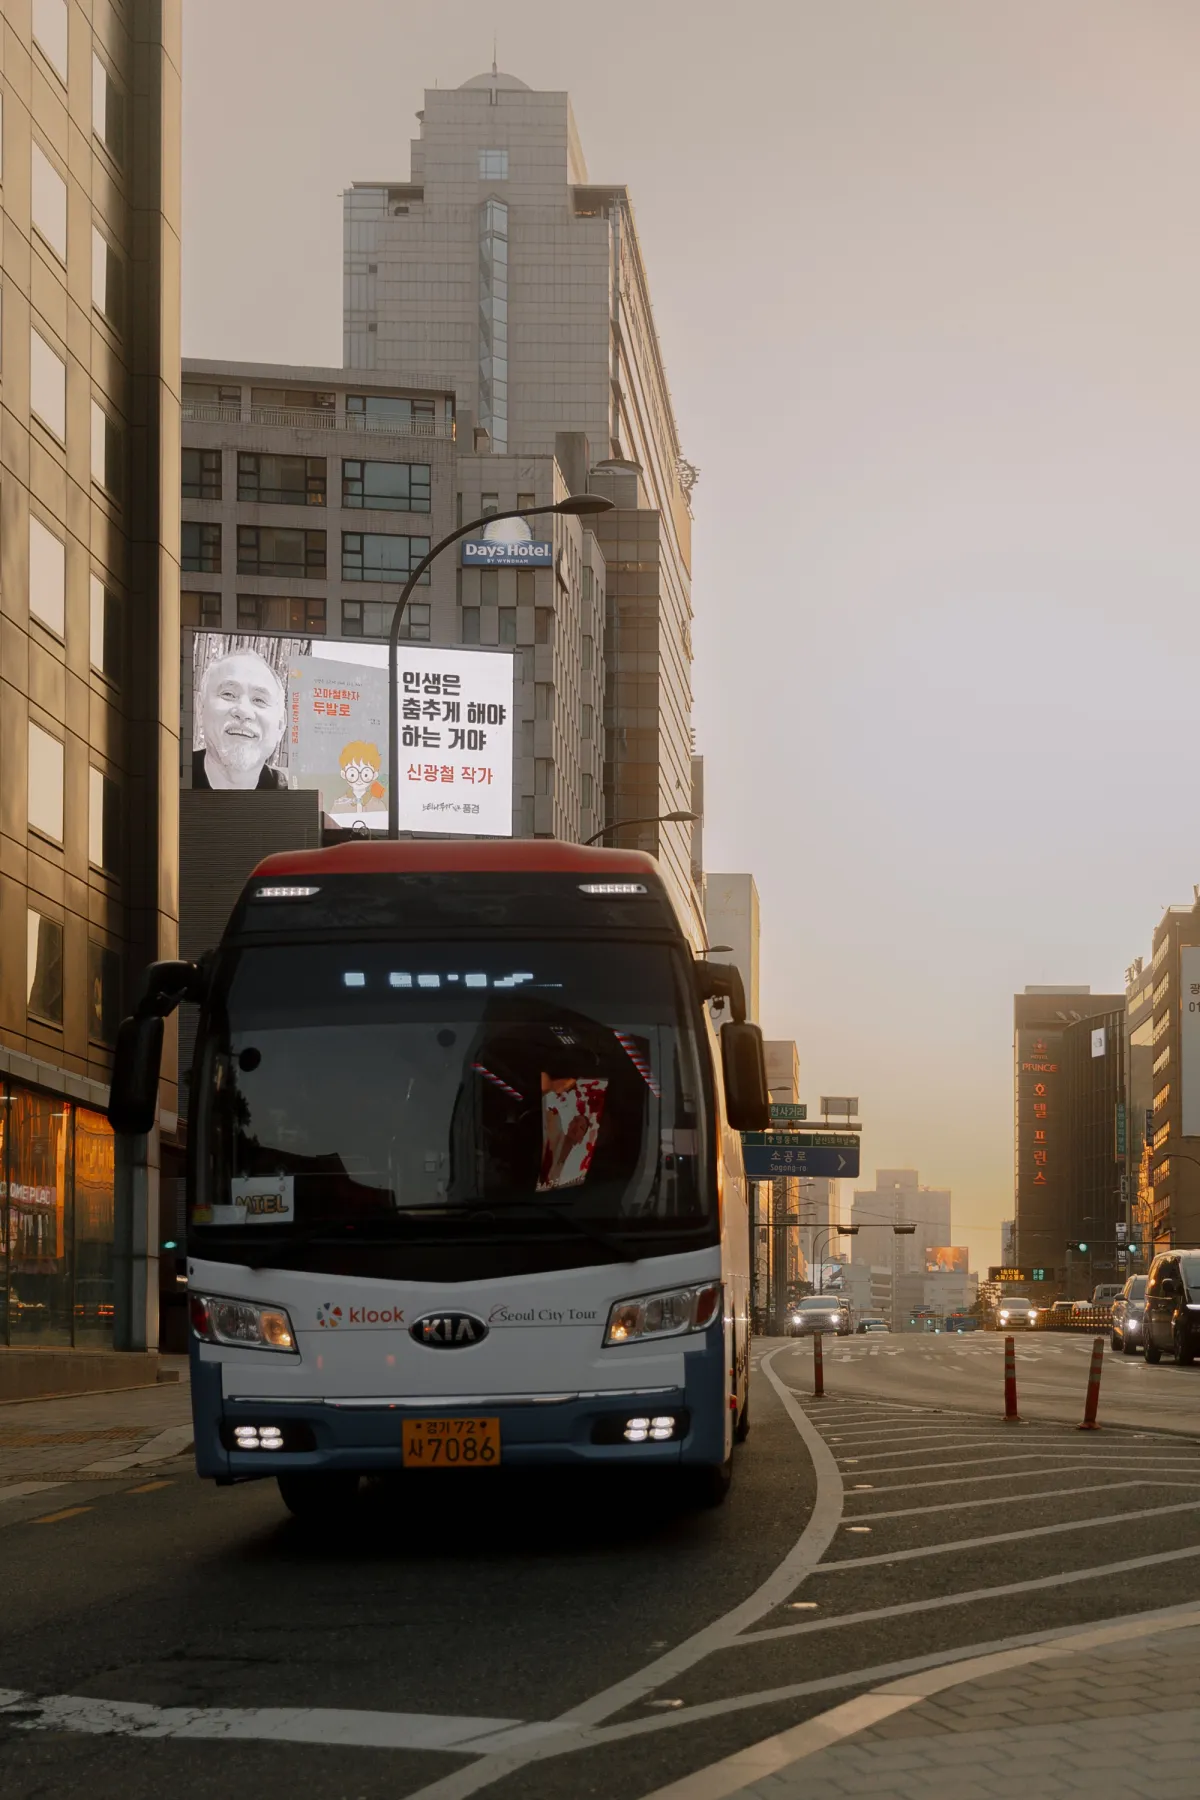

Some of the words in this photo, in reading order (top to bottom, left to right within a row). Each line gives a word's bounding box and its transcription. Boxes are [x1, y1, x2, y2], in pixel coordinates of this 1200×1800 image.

[465, 543, 505, 557] Days
[402, 671, 461, 697] 인생은
[313, 687, 360, 701] 꼬마철학자
[313, 701, 351, 717] 두발로
[402, 697, 461, 723] 춤추게
[467, 701, 506, 726] 해야
[402, 724, 441, 749] 하는
[448, 727, 487, 751] 거야
[407, 763, 454, 783] 신광철
[461, 766, 493, 785] 작가
[1022, 1063, 1058, 1073] PRINCE
[1033, 1082, 1047, 1119] 호텔
[770, 1150, 807, 1163] 소공로
[1033, 1130, 1047, 1185] 프린스
[770, 1163, 807, 1173] Sogong-ro
[235, 1194, 290, 1215] MIEL
[350, 1307, 405, 1323] klook
[489, 1308, 535, 1322] Seoul
[538, 1308, 564, 1324] City
[567, 1307, 598, 1320] Tour
[422, 1319, 476, 1341] KIA
